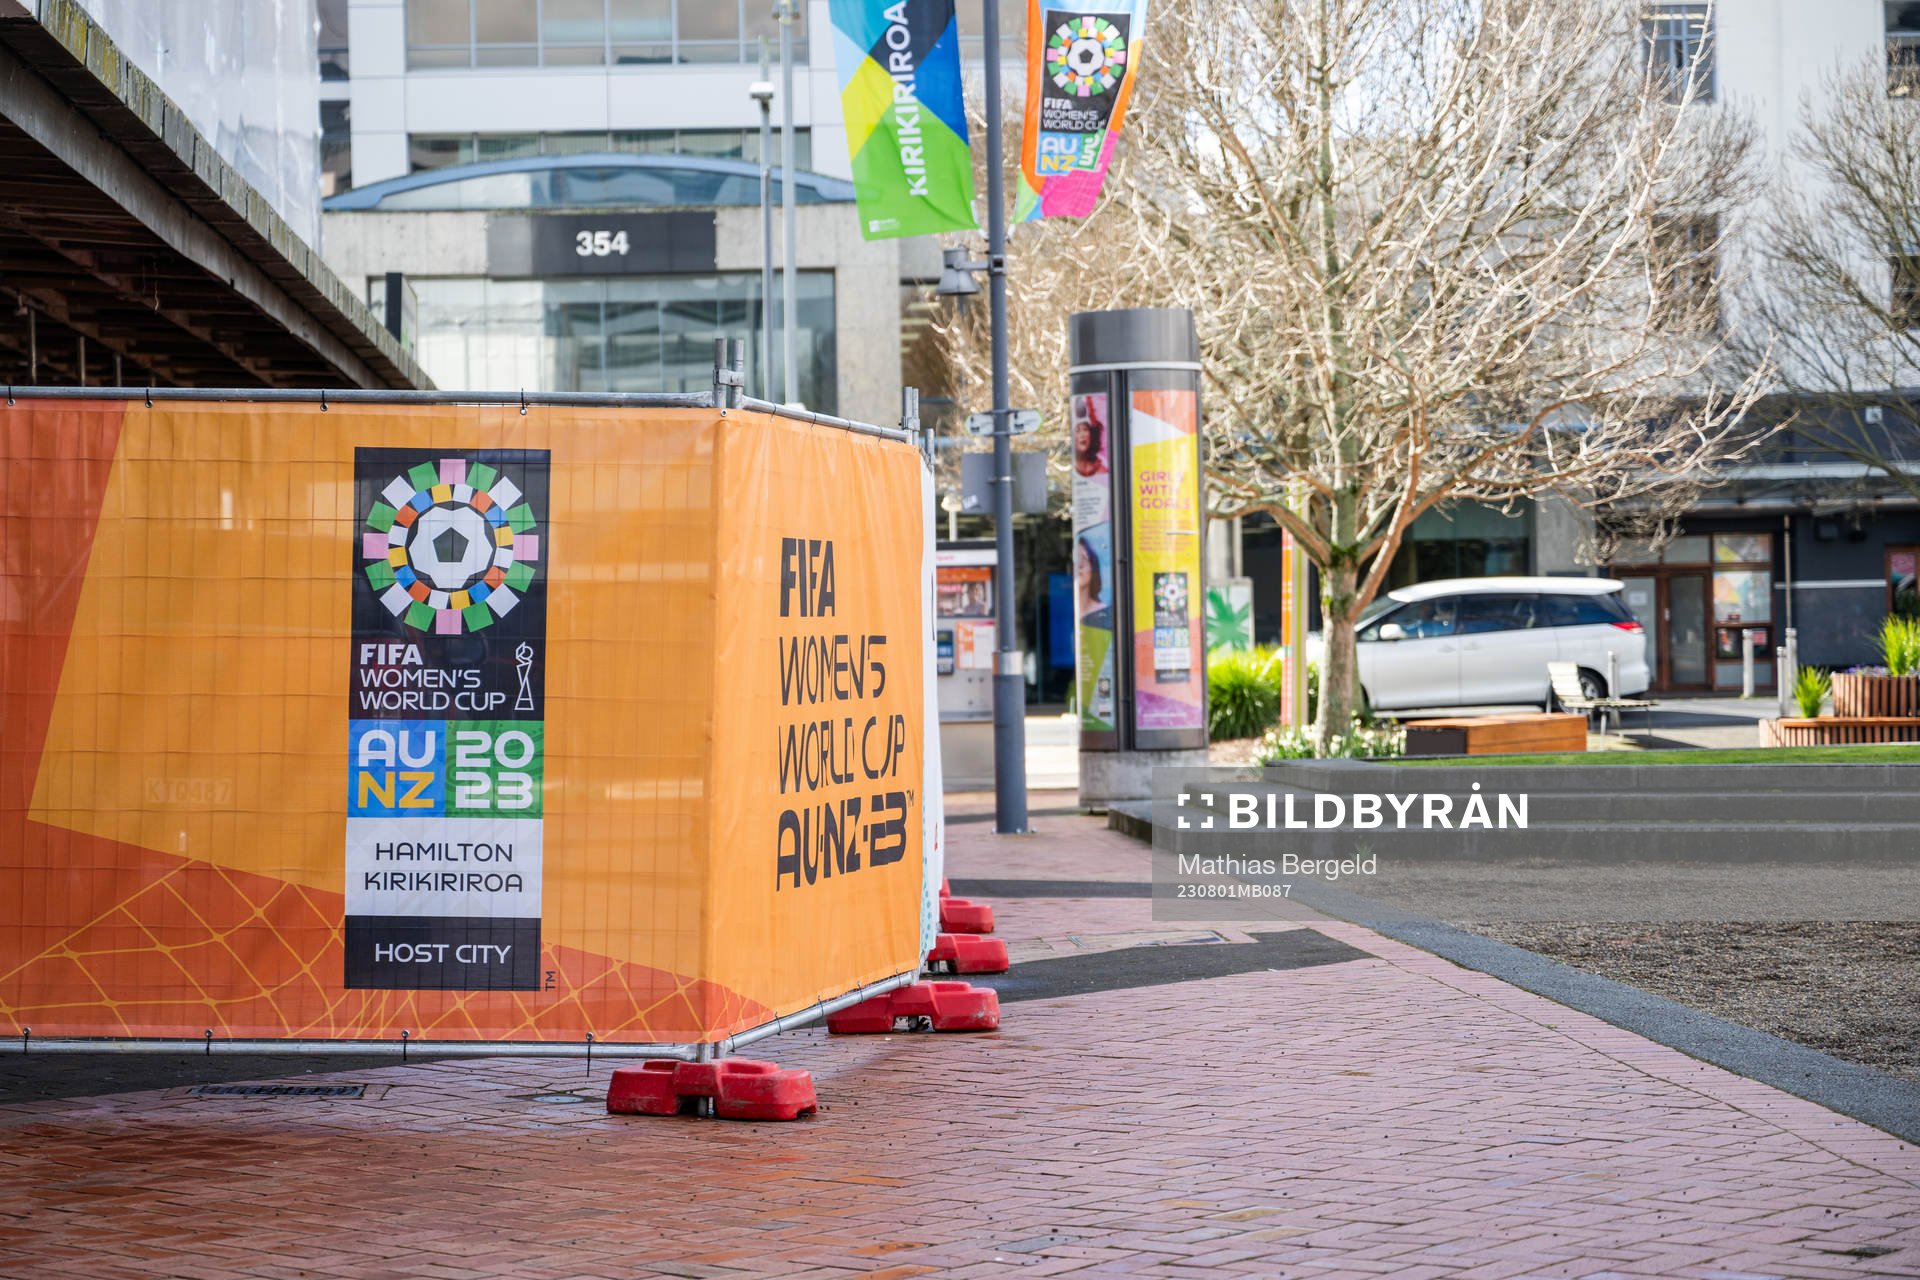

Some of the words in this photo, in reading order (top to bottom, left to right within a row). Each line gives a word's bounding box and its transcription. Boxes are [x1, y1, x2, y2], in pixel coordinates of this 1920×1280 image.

[884, 2, 929, 197] KIRIKIRIROA
[1044, 97, 1073, 110] FIFA
[1043, 109, 1099, 120] WOMEN'S
[1043, 119, 1084, 130] WORLD
[1041, 137, 1078, 154] AU
[1041, 154, 1076, 170] NZ
[576, 231, 630, 256] 354
[779, 537, 835, 618] FIFA
[360, 644, 423, 665] FIFA
[360, 669, 481, 688] WOMEN'S
[359, 691, 450, 711] WORLD
[455, 692, 506, 711] CUP
[358, 729, 436, 768] AU
[455, 730, 535, 768] 20
[357, 771, 435, 808] NZ
[455, 772, 534, 809] 23
[376, 842, 512, 862] HAMILTON
[365, 872, 523, 892] KIRIKIRIROA
[375, 943, 449, 963] HOST
[455, 944, 512, 964] CITY
